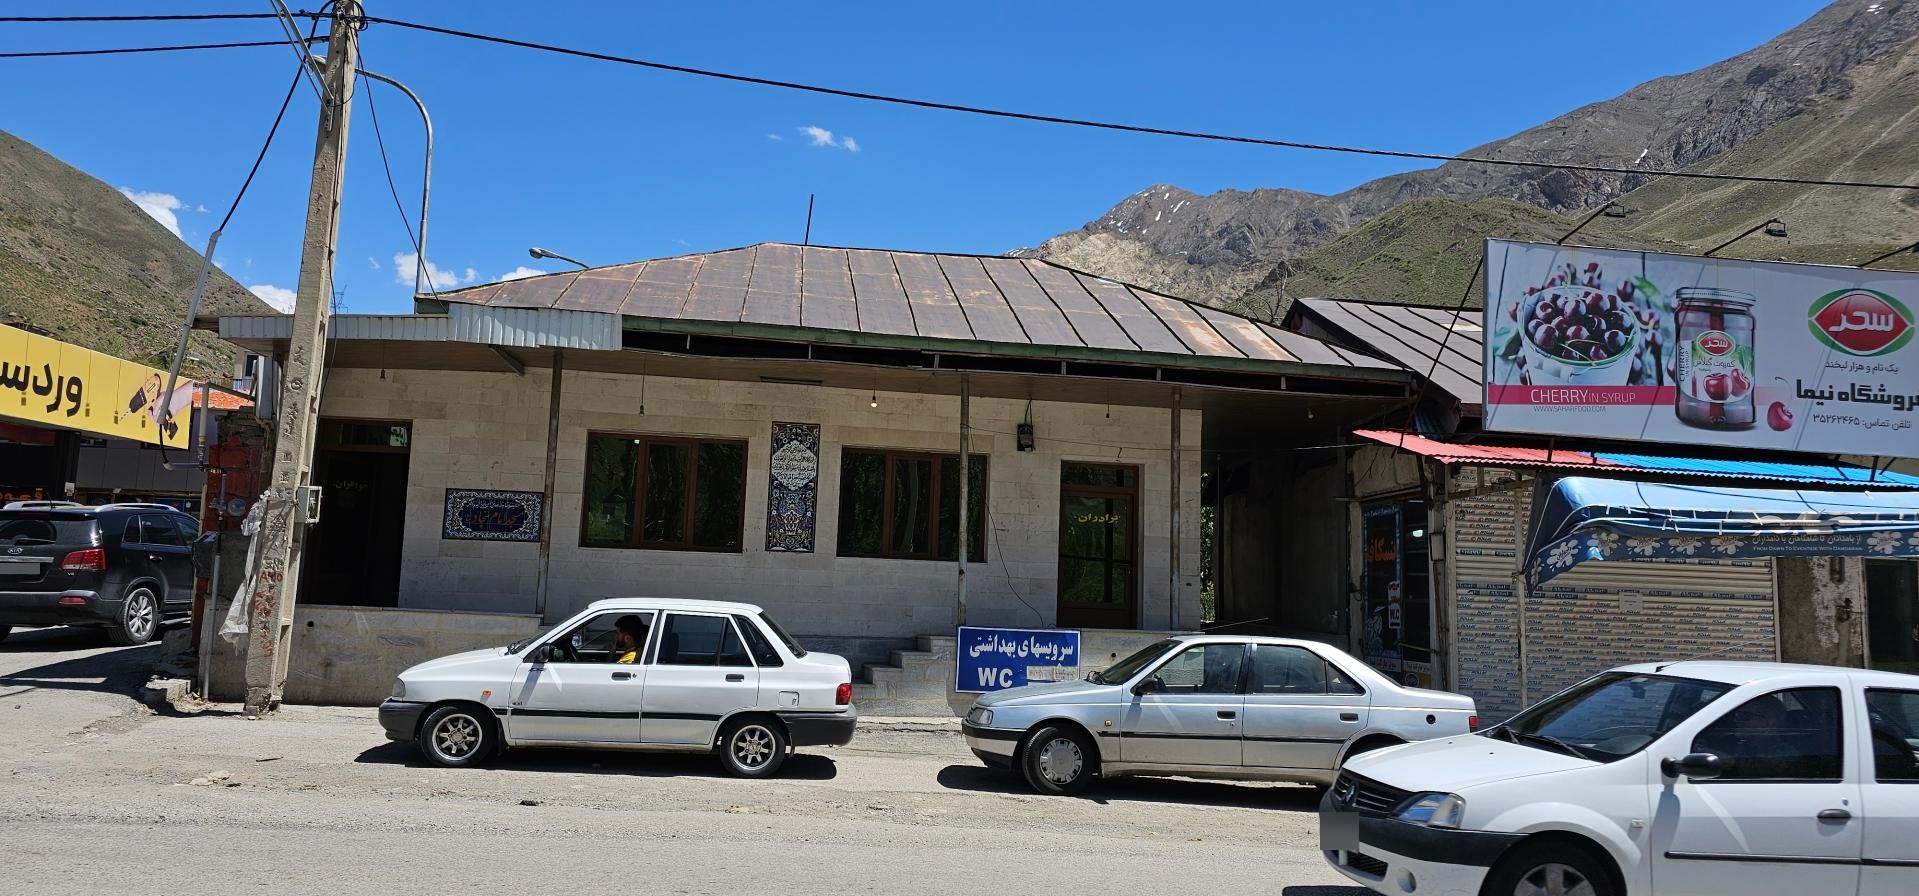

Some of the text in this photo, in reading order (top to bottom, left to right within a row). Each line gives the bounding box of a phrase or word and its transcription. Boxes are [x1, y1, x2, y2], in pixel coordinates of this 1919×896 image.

[1828, 311, 1894, 332] سحر
[1704, 339, 1728, 348] سحر
[1825, 360, 1848, 372] لبخند
[1849, 362, 1864, 373] هزار
[1872, 362, 1884, 374] نام
[1886, 363, 1899, 375] یک
[1530, 389, 1636, 403] CHERRY IN SYRUP
[1796, 378, 1834, 406] نیما
[1891, 419, 1912, 431] تلفن
[969, 633, 1017, 660] بهداشتی
[977, 667, 1014, 688] WC
